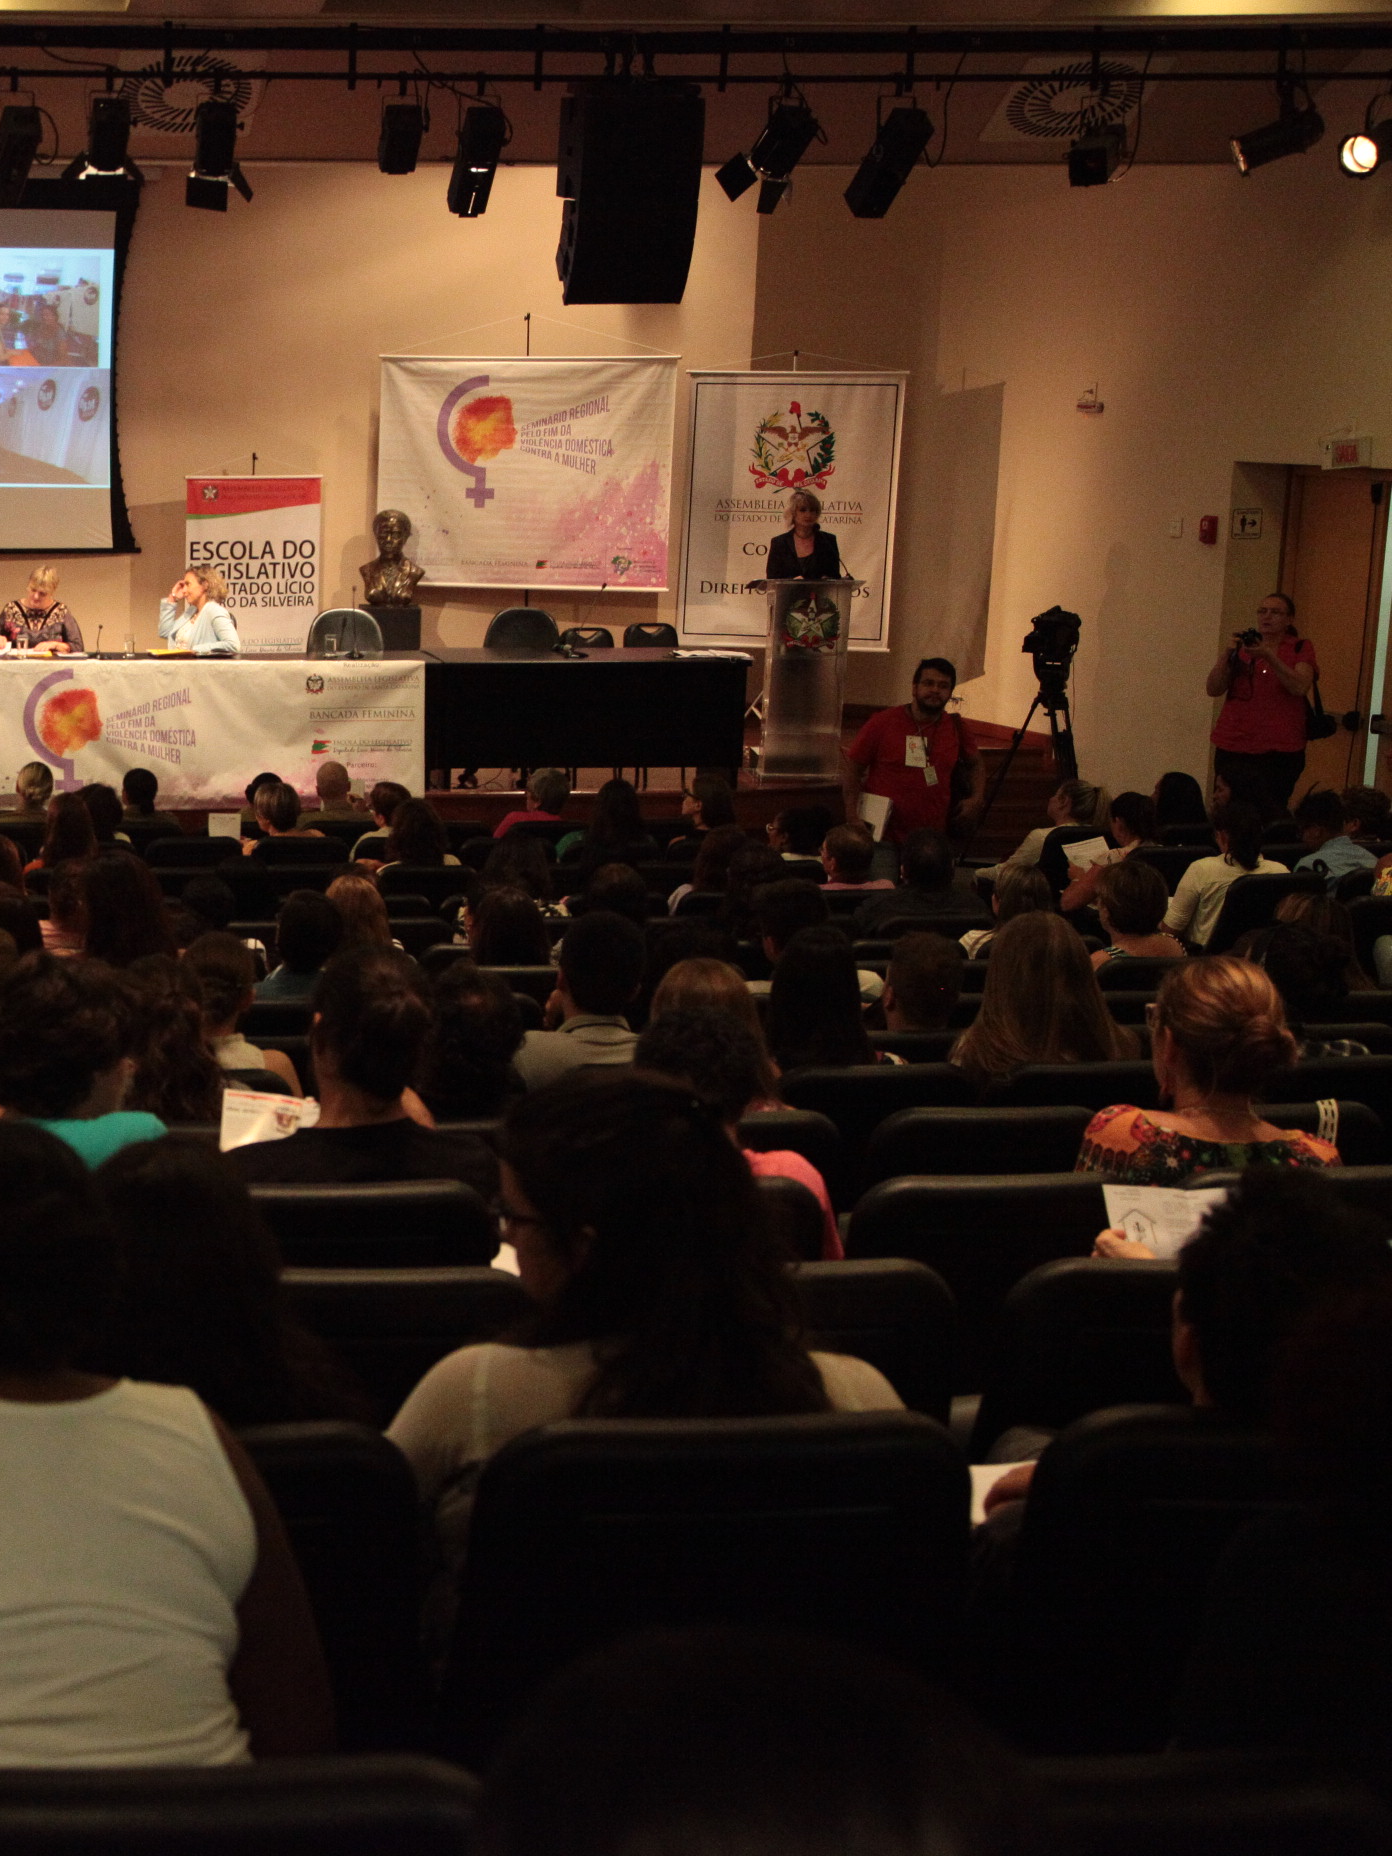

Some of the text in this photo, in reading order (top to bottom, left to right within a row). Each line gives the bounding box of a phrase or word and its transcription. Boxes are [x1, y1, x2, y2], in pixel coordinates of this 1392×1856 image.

[569, 395, 610, 420] REGIONAL
[520, 424, 571, 438] PELO FIM DA
[565, 436, 612, 457] DOMÉSTICA
[520, 446, 596, 475] CONTRA A MULHER
[716, 499, 863, 511] ASSEMBLEIA LATIVA
[714, 513, 863, 525] DO ESTADO DE ATARINA
[189, 539, 316, 561] ESCOLA DO
[189, 561, 316, 580] GISLATIVO
[276, 578, 315, 595] LÍCIO
[240, 597, 258, 608] DA
[261, 595, 314, 608] SILVEIRA
[152, 687, 192, 713] REGIONAL
[106, 715, 156, 729] PELO FIM DA
[309, 709, 416, 720] BANCADA FEMININA
[149, 726, 196, 748] DOMÉSTICA
[140, 742, 146, 754] A
[148, 743, 181, 766] MULHER
